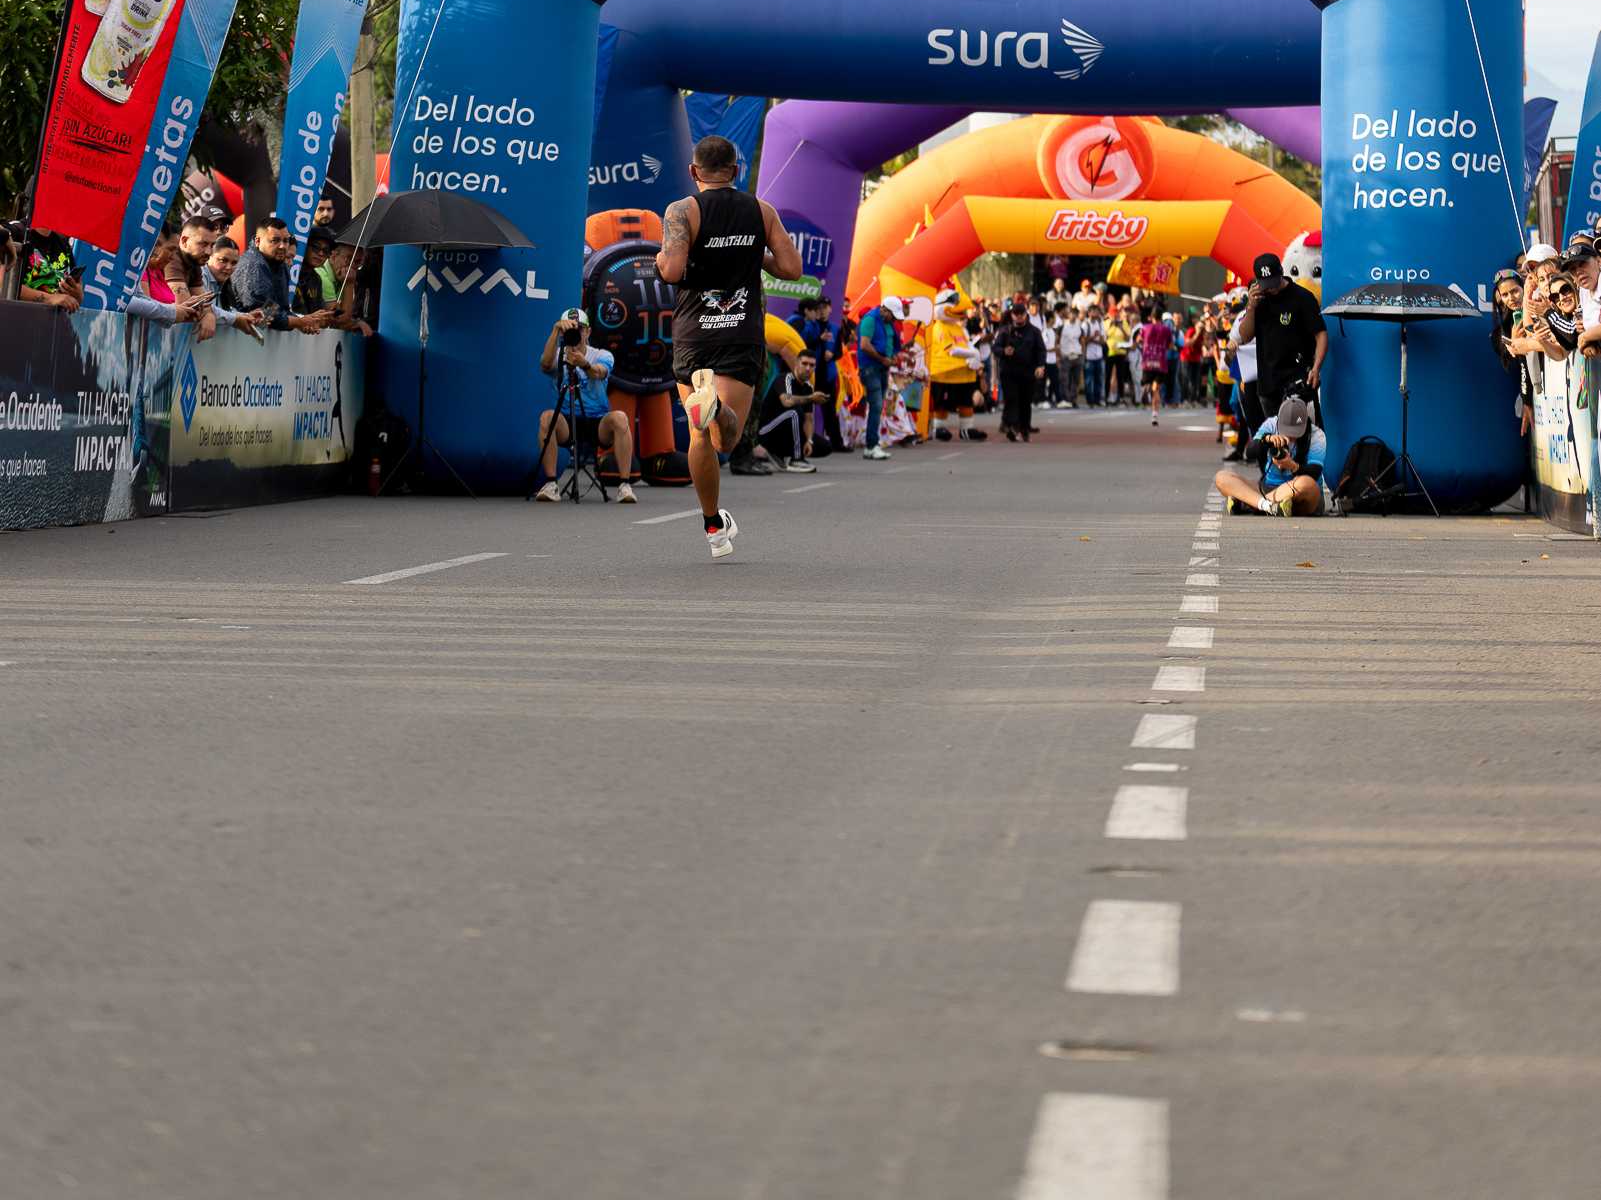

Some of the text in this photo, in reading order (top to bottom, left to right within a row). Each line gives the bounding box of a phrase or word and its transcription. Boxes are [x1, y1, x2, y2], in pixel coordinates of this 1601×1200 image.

[928, 28, 1048, 69] sura
[415, 94, 535, 126] Del lado
[1351, 109, 1477, 140] Del lado
[298, 110, 323, 155] de
[413, 127, 559, 165] de los que
[140, 95, 193, 235] metas
[588, 162, 639, 184] sura
[1352, 143, 1501, 178] de los que
[411, 163, 508, 194] hacen.
[291, 165, 317, 245] lado
[1353, 181, 1454, 209] hacen.
[704, 234, 755, 248] JONATHAN
[1048, 211, 1147, 247] Frisby
[423, 248, 479, 264] Grupo
[807, 236, 832, 267] FIT
[407, 264, 549, 300] AVAL
[1370, 267, 1430, 282] Grupo
[699, 313, 746, 323] GUERREROS
[713, 321, 738, 329] LIMITES
[201, 376, 283, 407] Banco de Occidente
[294, 376, 304, 402] TU
[7, 391, 62, 431] Occidente
[77, 391, 92, 425] TU
[6, 459, 21, 483] que
[22, 450, 47, 477] hacen.
[74, 435, 132, 472] IMPACTA.
[150, 492, 166, 507] AVAL
